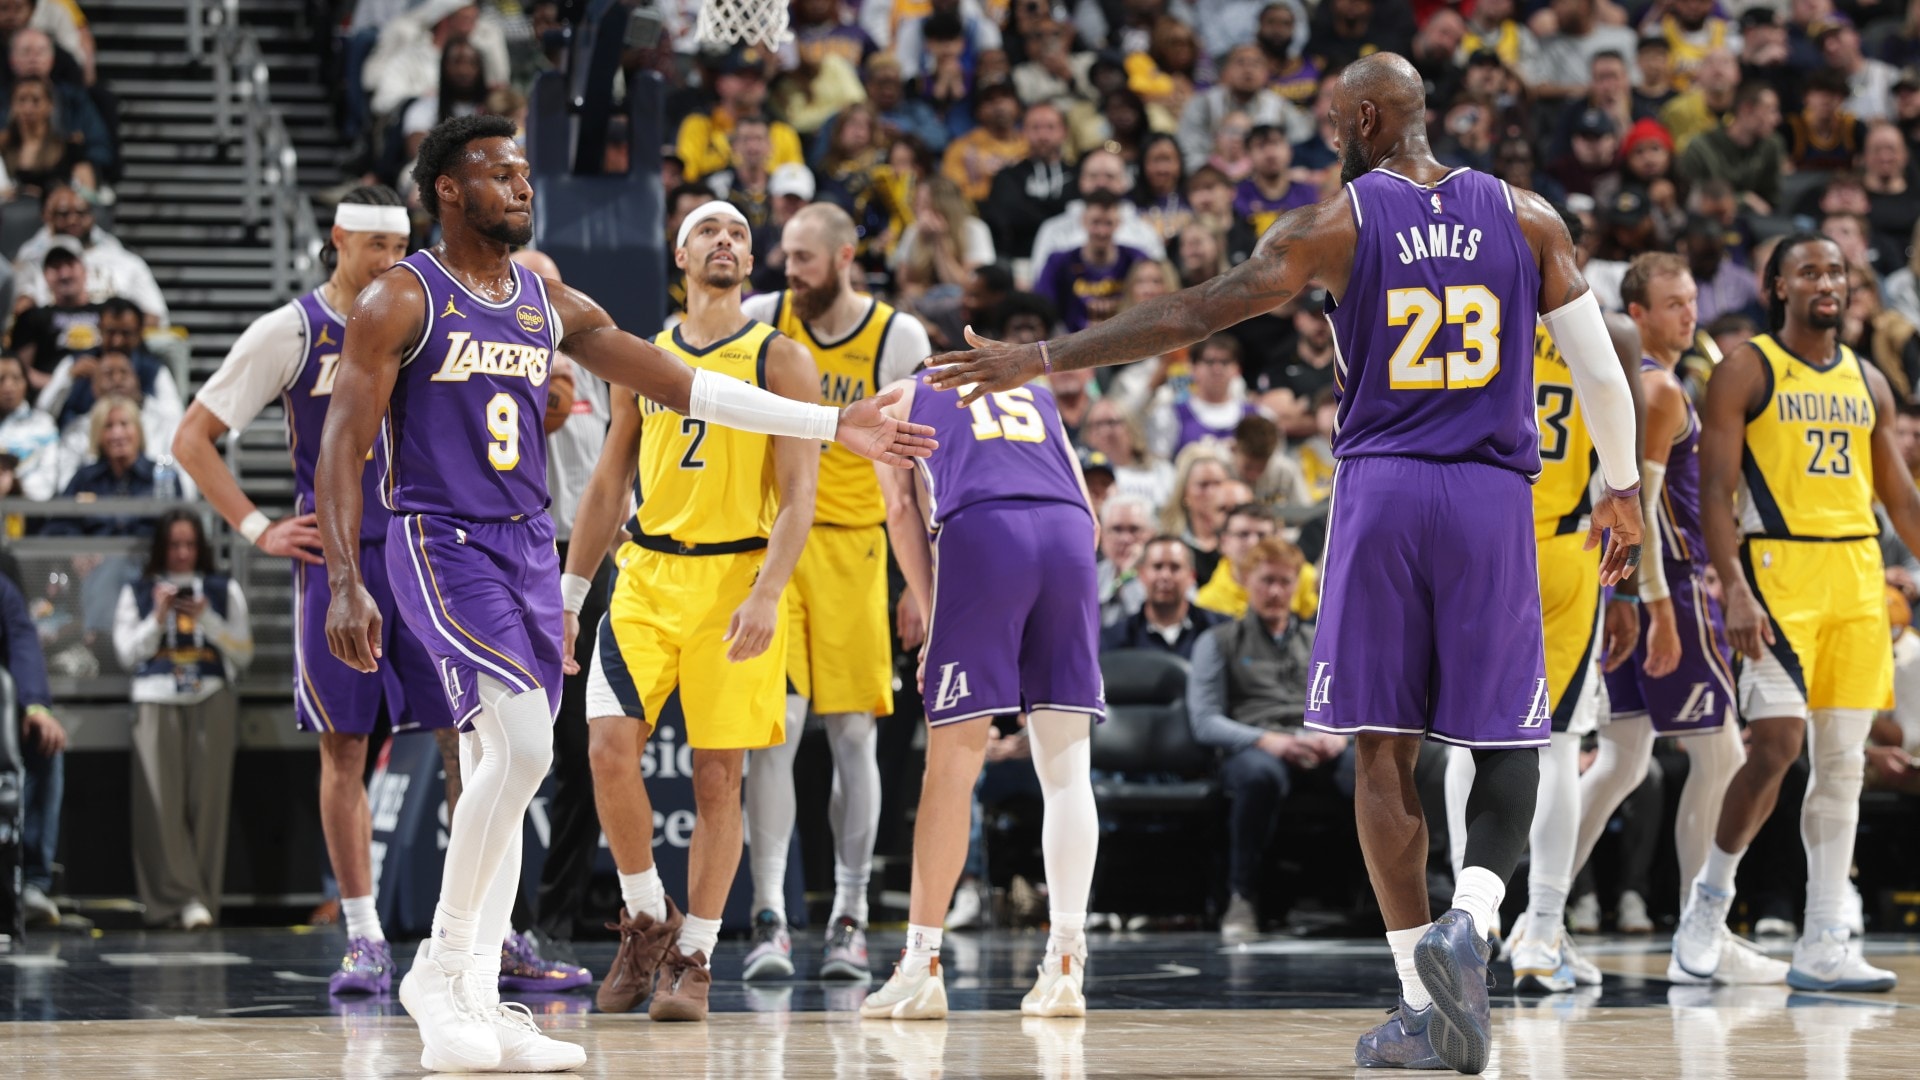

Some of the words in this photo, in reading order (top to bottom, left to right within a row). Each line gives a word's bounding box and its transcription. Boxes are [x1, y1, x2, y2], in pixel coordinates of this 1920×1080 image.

[1395, 223, 1482, 265] JAMES
[518, 311, 542, 325] bibigo
[1386, 284, 1501, 390] 23
[430, 331, 550, 387] LAKERS
[486, 392, 520, 471] 9
[957, 382, 1047, 444] 15
[1537, 384, 1573, 461] 3
[1776, 392, 1871, 427] INDIANA
[679, 418, 708, 470] 2
[1805, 428, 1851, 477] 23
[931, 661, 972, 712] LA
[1307, 661, 1332, 712] LA
[1671, 681, 1715, 723] LA
